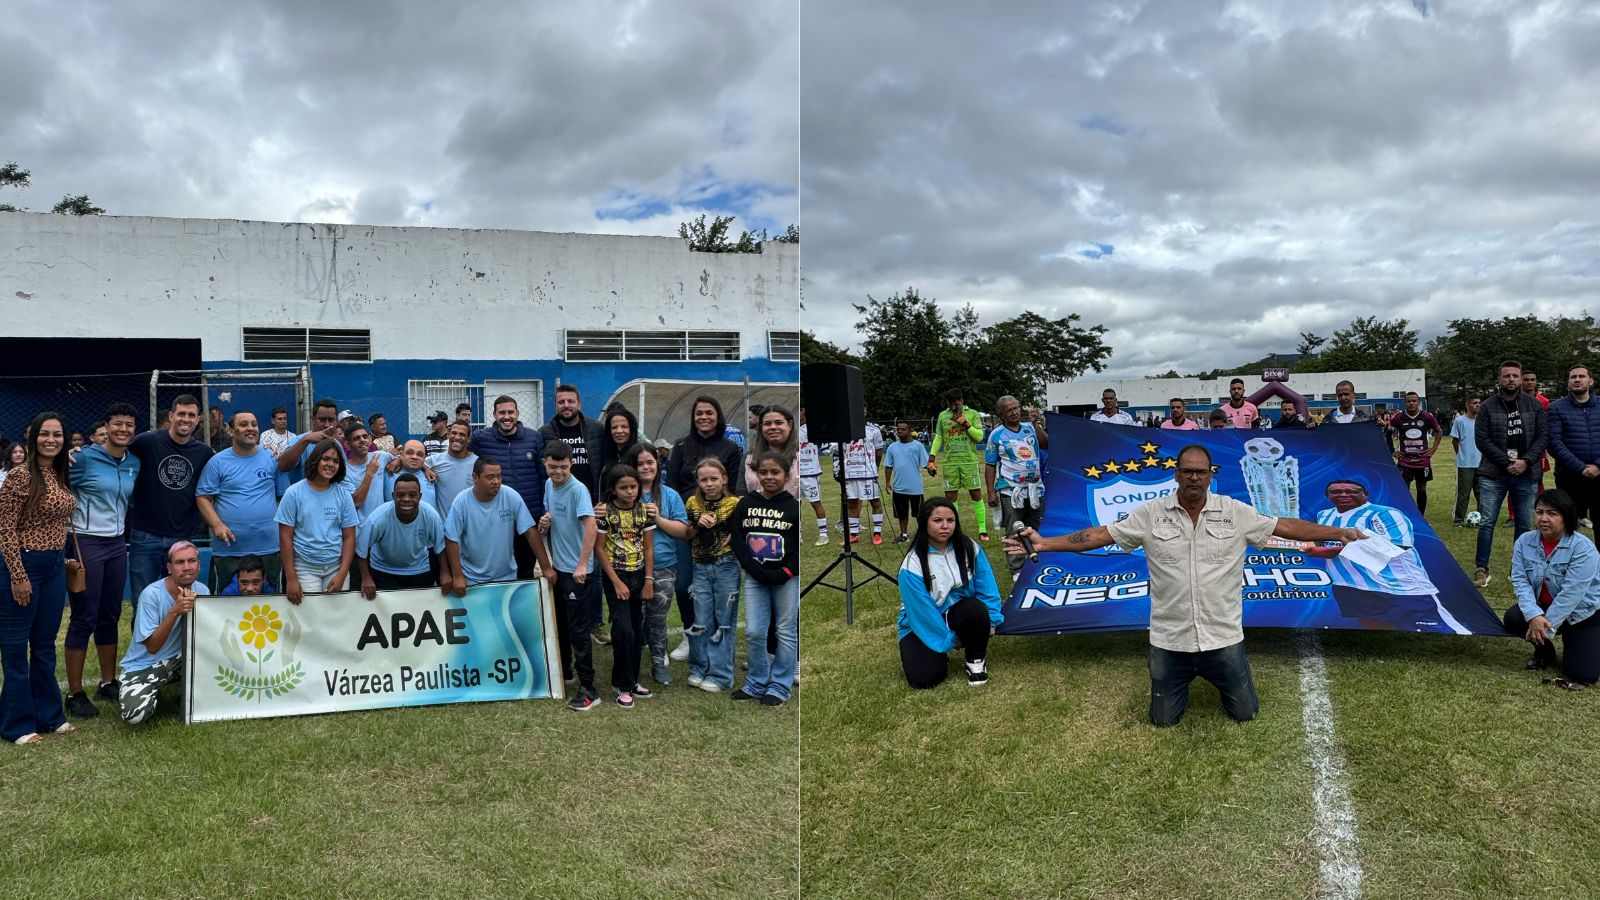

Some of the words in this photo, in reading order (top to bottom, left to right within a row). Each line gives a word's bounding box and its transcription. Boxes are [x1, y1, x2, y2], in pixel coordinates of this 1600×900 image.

[747, 507, 785, 519] FOLLOW
[762, 518, 793, 530] HEART
[1037, 566, 1137, 587] Eterno
[1247, 553, 1304, 565] ente
[1242, 568, 1332, 586] HO
[1245, 587, 1327, 600] ondrina
[357, 607, 471, 651] APAE
[324, 668, 394, 698] Várzea
[400, 663, 481, 693] Paulista
[487, 657, 521, 685] -SP
